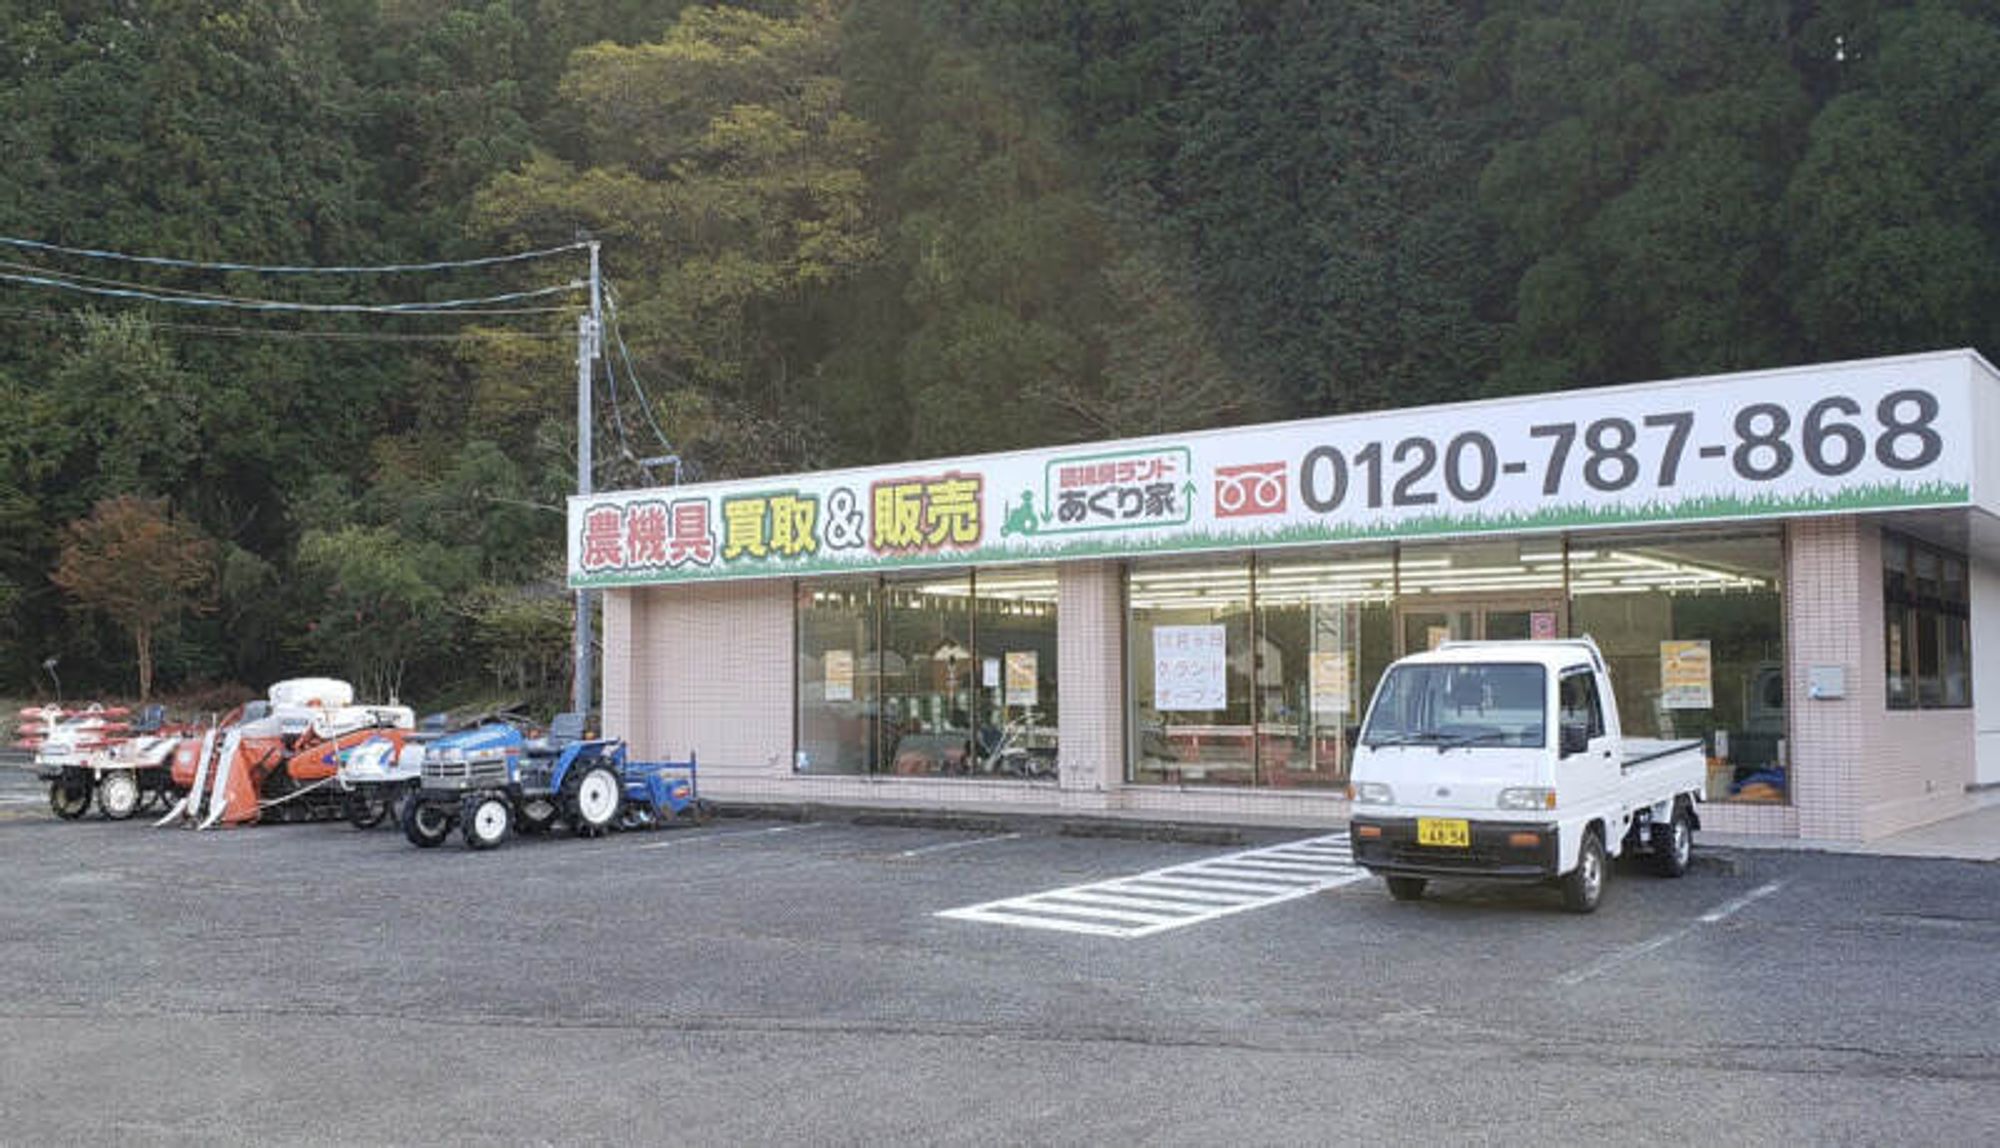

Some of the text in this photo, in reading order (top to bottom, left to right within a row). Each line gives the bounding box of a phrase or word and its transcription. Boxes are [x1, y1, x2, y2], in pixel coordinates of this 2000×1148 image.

[1300, 389, 1944, 514] 0120-787-868
[583, 475, 981, 570] 農機具 買取 & 販売
